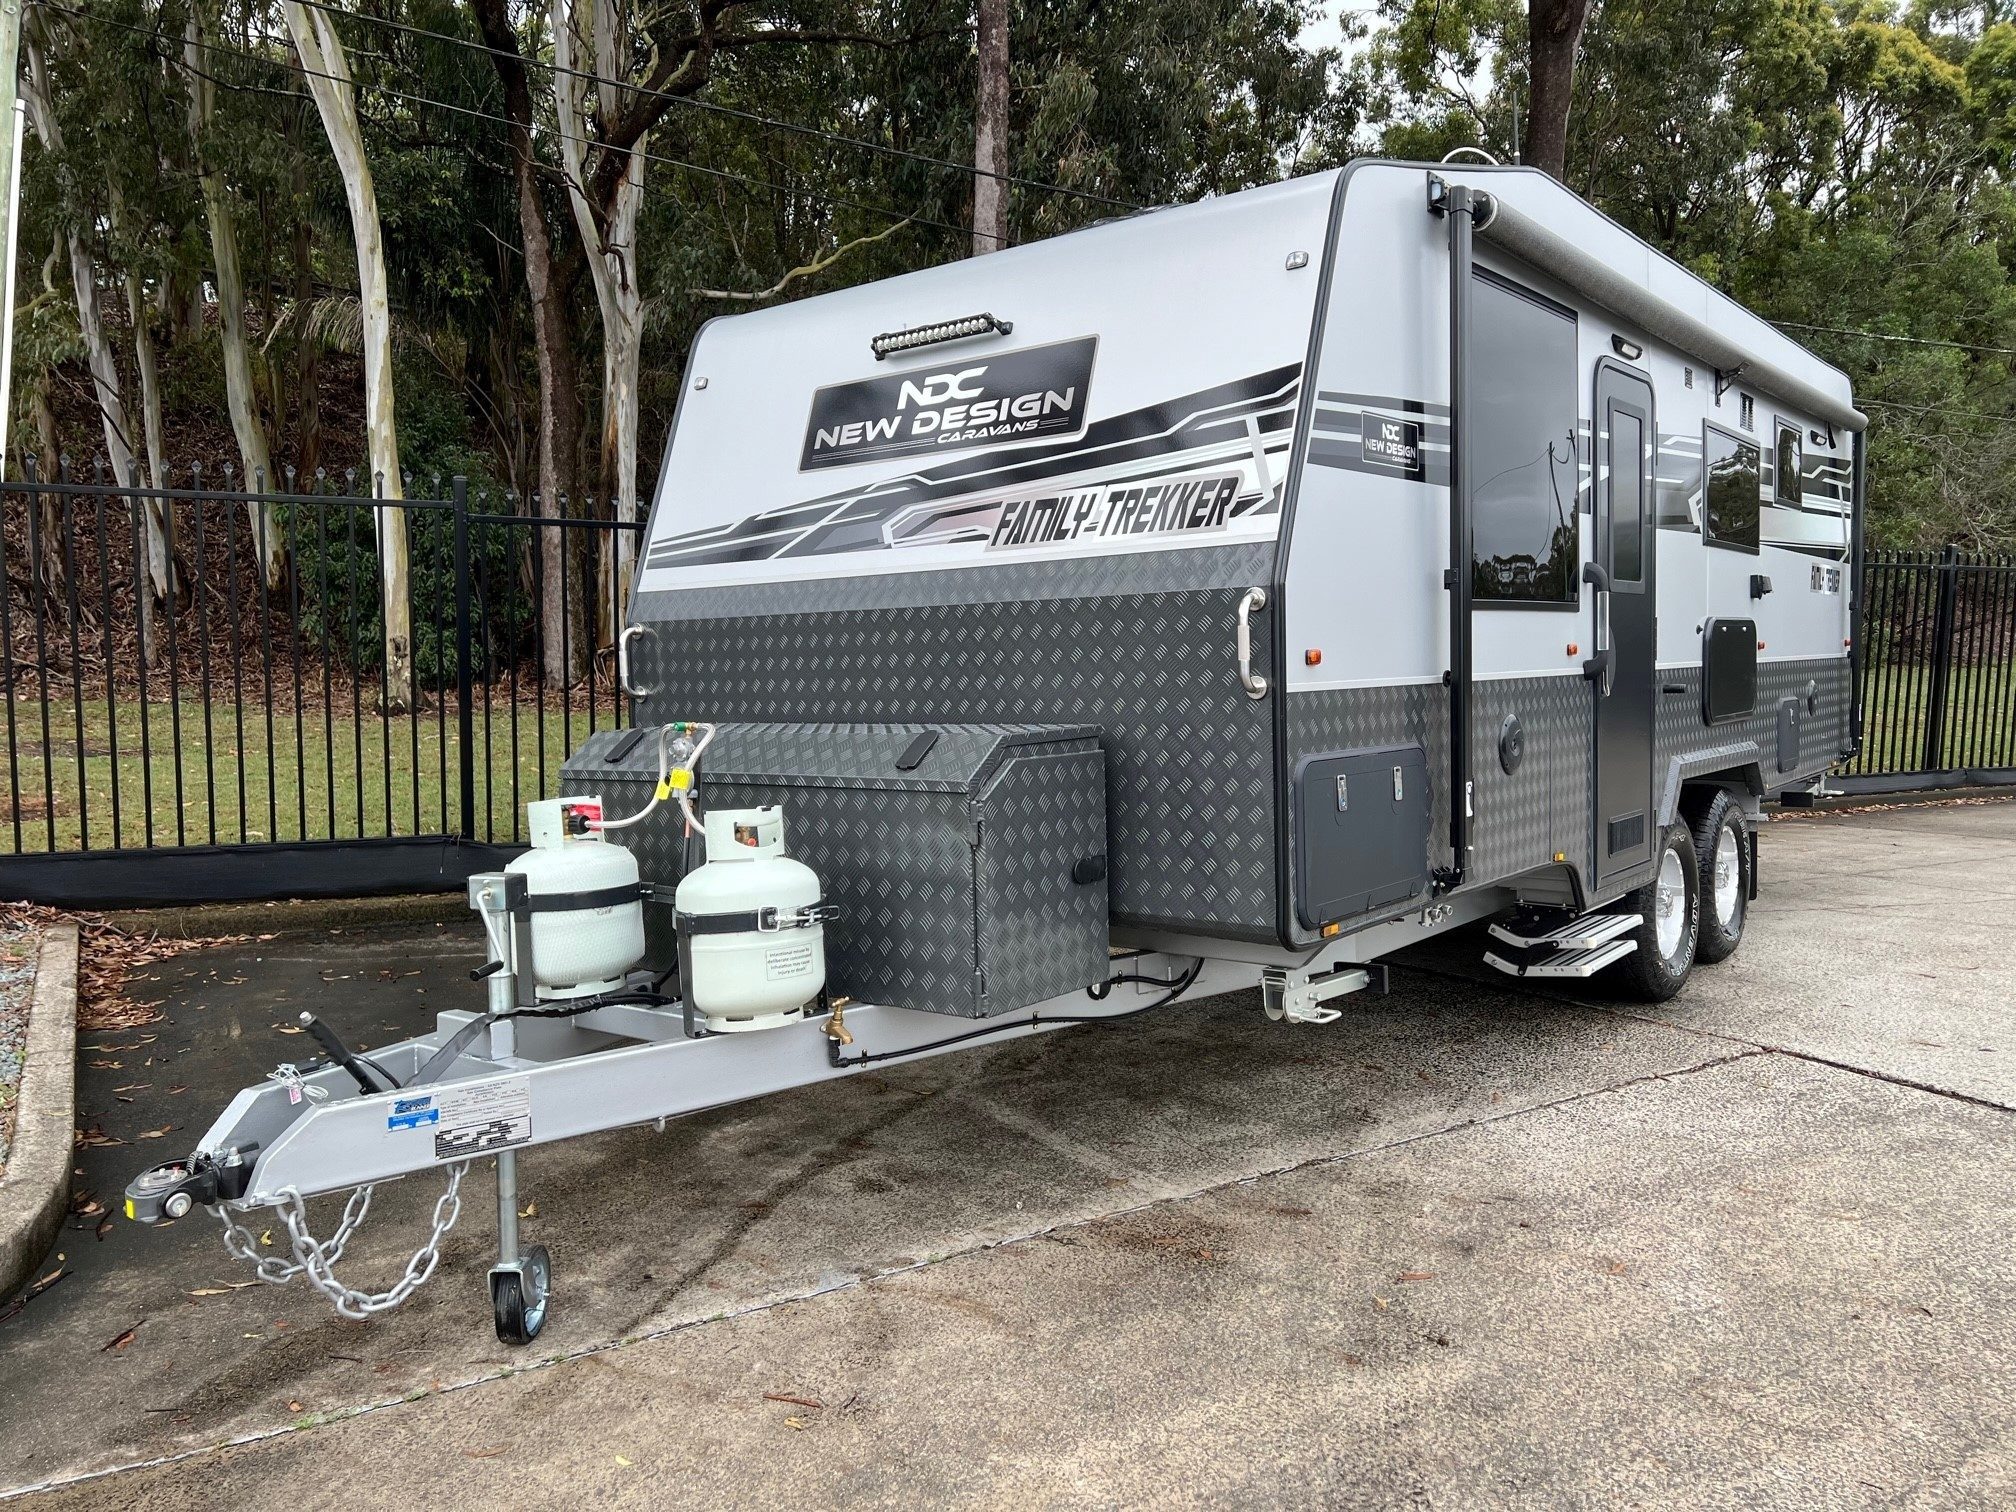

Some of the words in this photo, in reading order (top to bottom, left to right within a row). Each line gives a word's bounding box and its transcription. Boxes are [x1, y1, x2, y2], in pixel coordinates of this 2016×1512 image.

[897, 366, 988, 410] NDC
[814, 415, 902, 450] NEW
[911, 387, 1074, 435] DESIGN
[937, 419, 1040, 444] CARAVANS
[1382, 422, 1400, 441] NDC
[1365, 437, 1385, 453] NEW
[1386, 441, 1416, 459] DESIGN
